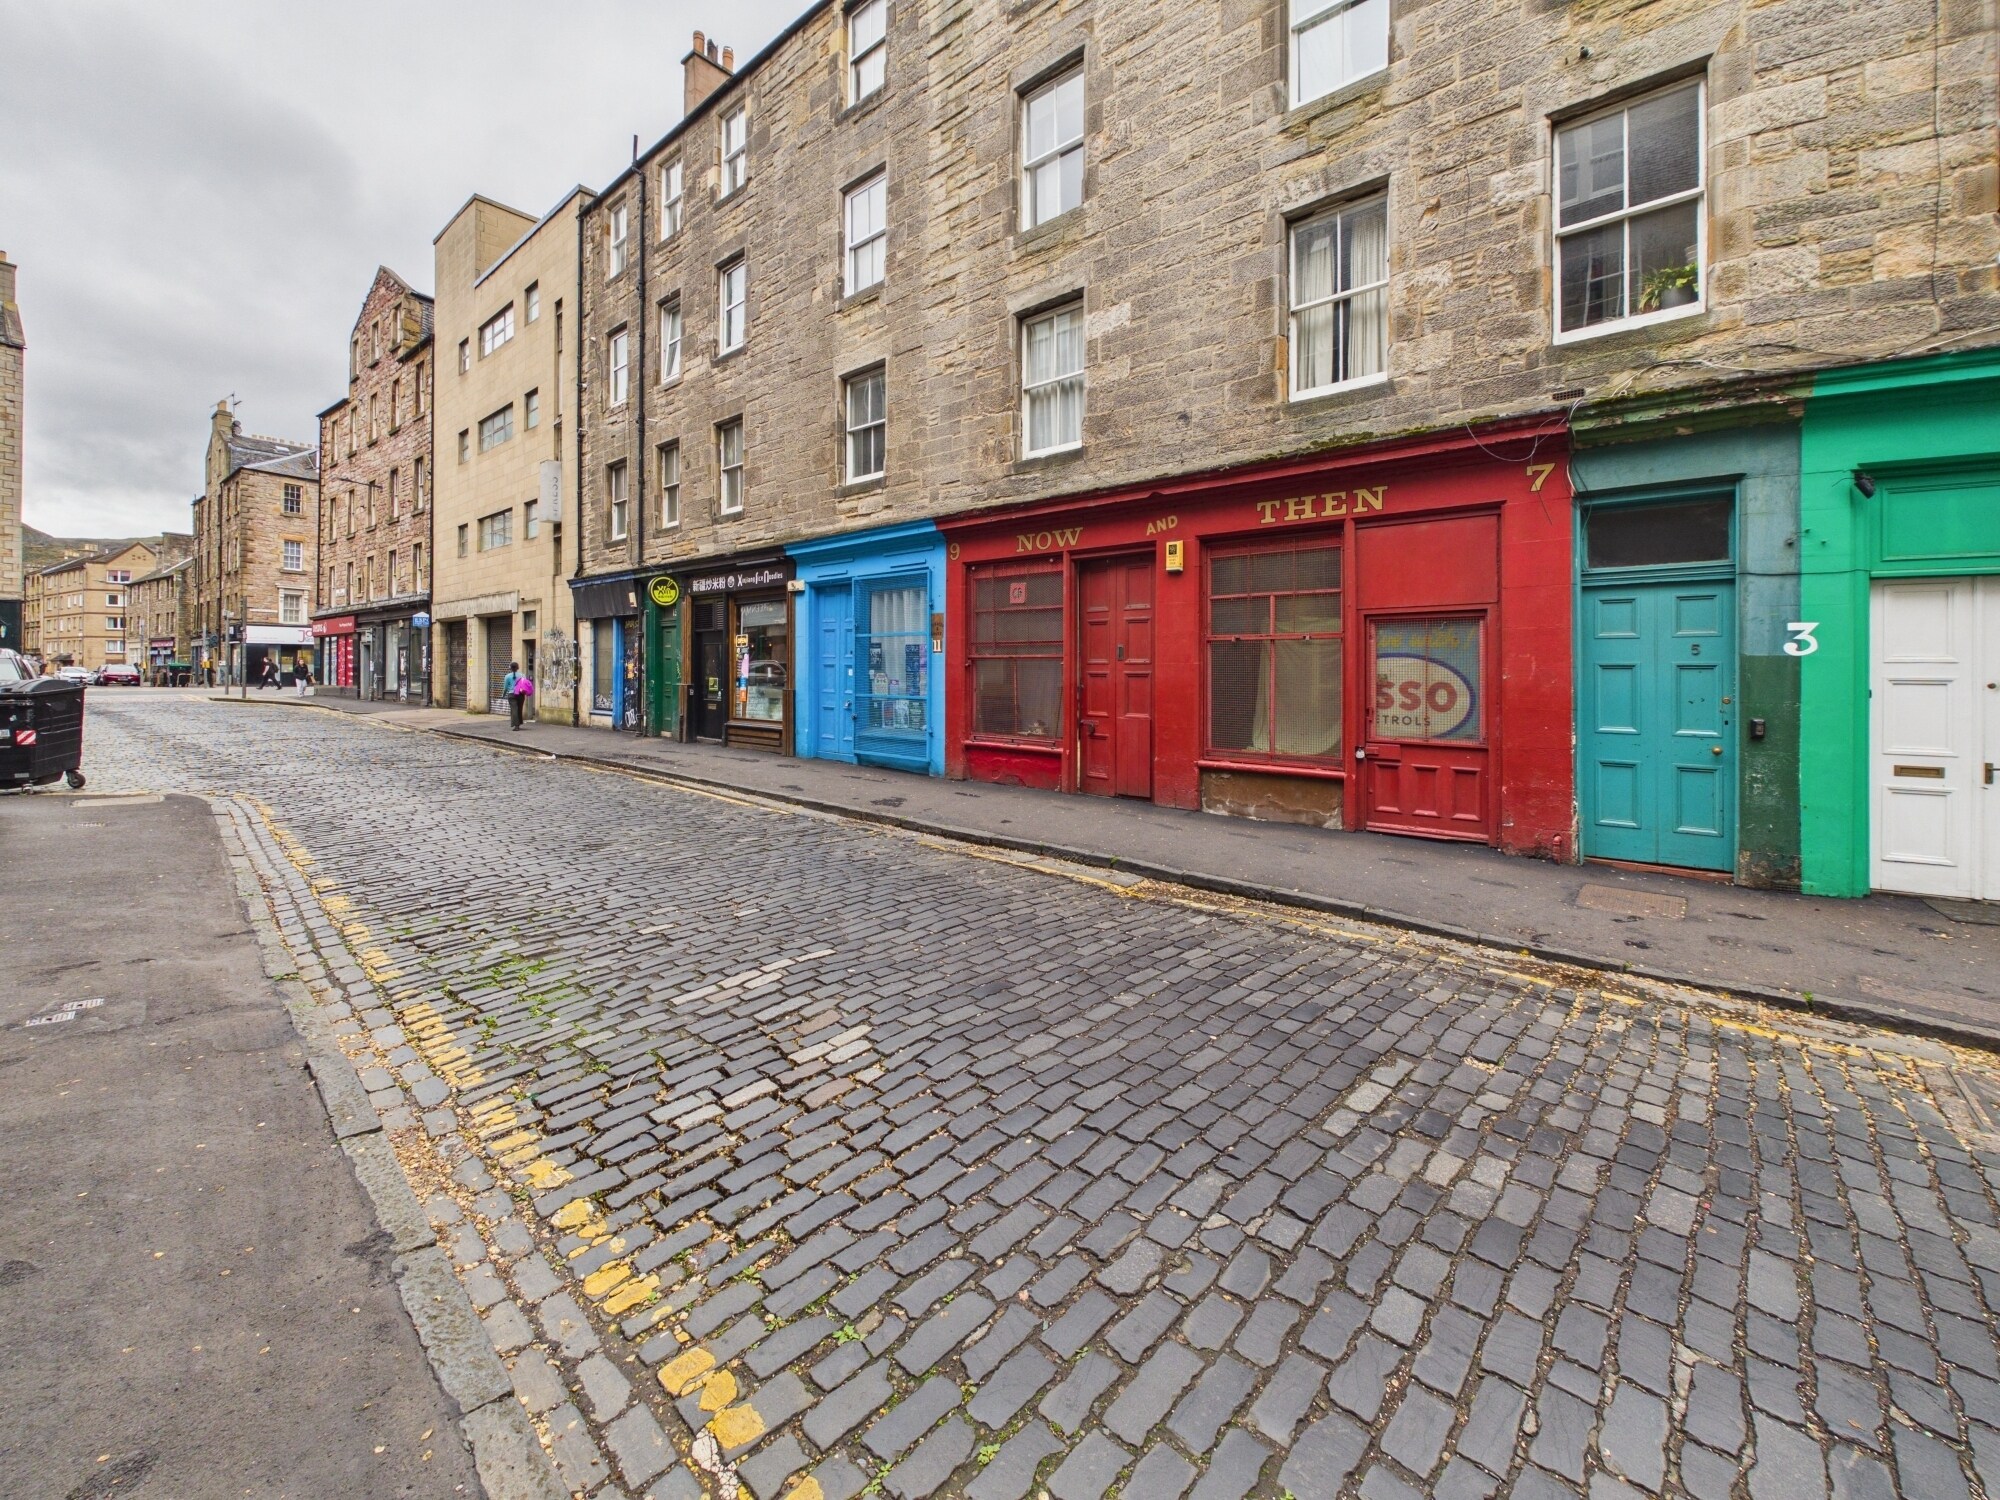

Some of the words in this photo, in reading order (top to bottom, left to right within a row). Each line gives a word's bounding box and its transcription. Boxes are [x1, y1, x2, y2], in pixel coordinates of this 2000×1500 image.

[1526, 462, 1556, 492] 7
[1016, 527, 1083, 552] NOW
[1146, 515, 1178, 536] AND
[1256, 485, 1389, 524] THEN
[949, 542, 960, 560] 9
[933, 640, 942, 652] 11
[1691, 643, 1700, 656] 5
[1783, 622, 1820, 657] 3
